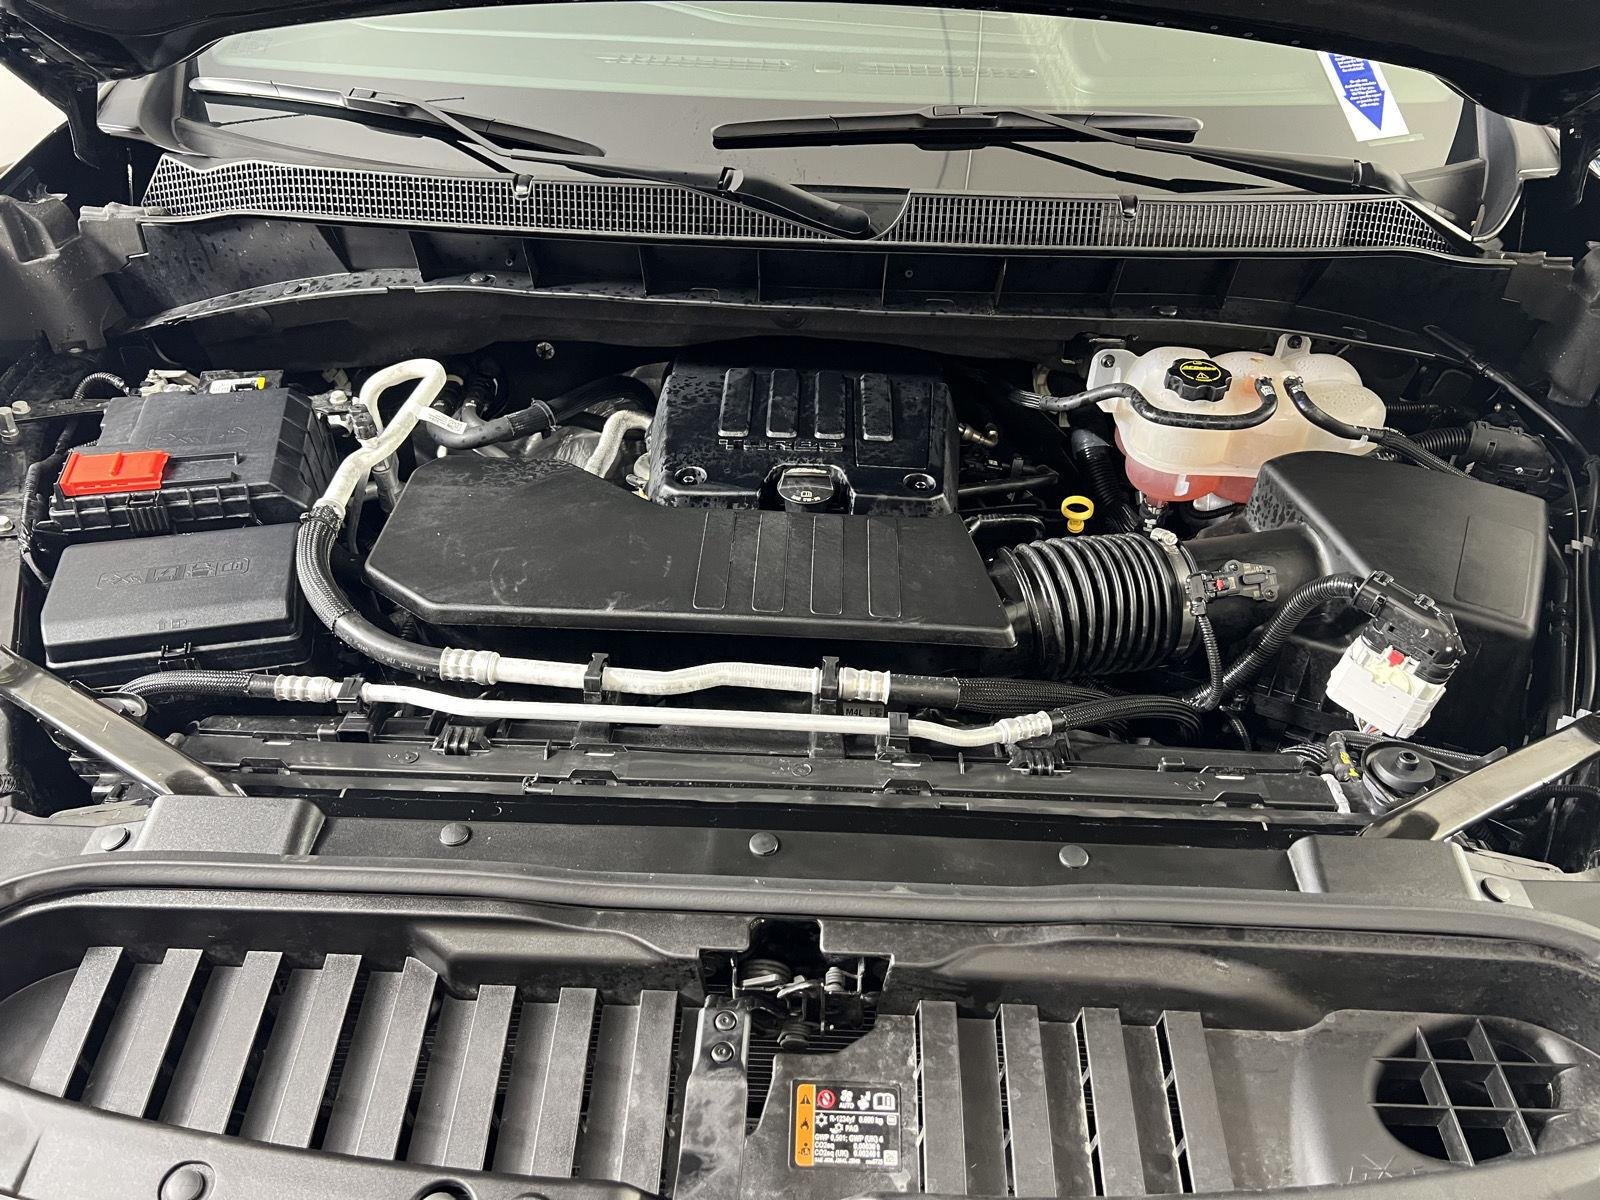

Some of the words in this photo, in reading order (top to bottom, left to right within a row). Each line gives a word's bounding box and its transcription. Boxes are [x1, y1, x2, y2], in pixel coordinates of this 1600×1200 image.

[845, 1124, 859, 1132] PAG
[814, 1133, 829, 1141] GWP
[848, 1134, 864, 1142] GWP
[814, 1141, 835, 1150] CO2eq
[814, 1149, 835, 1158] CO2eq
[835, 1149, 849, 1158] (UK)
